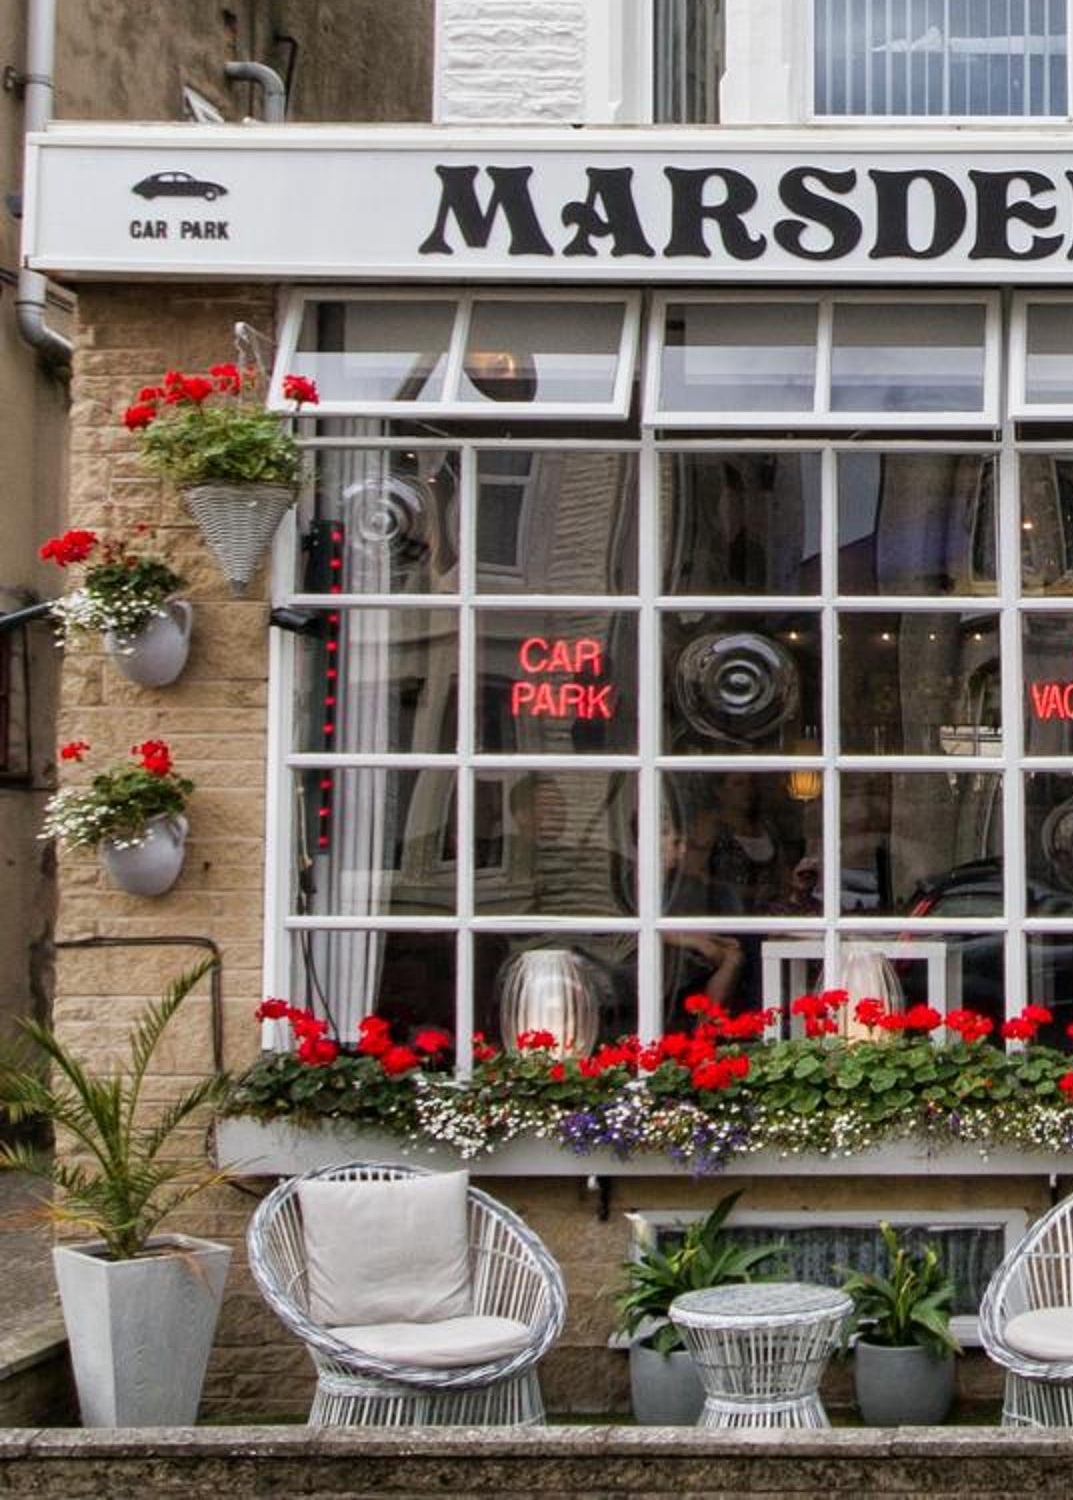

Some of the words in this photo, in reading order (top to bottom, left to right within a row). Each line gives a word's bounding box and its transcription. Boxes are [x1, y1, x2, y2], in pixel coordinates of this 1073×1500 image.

[129, 220, 168, 240] CAR
[180, 220, 230, 240] PARK
[518, 635, 603, 676] CAR
[510, 679, 614, 721] PARK
